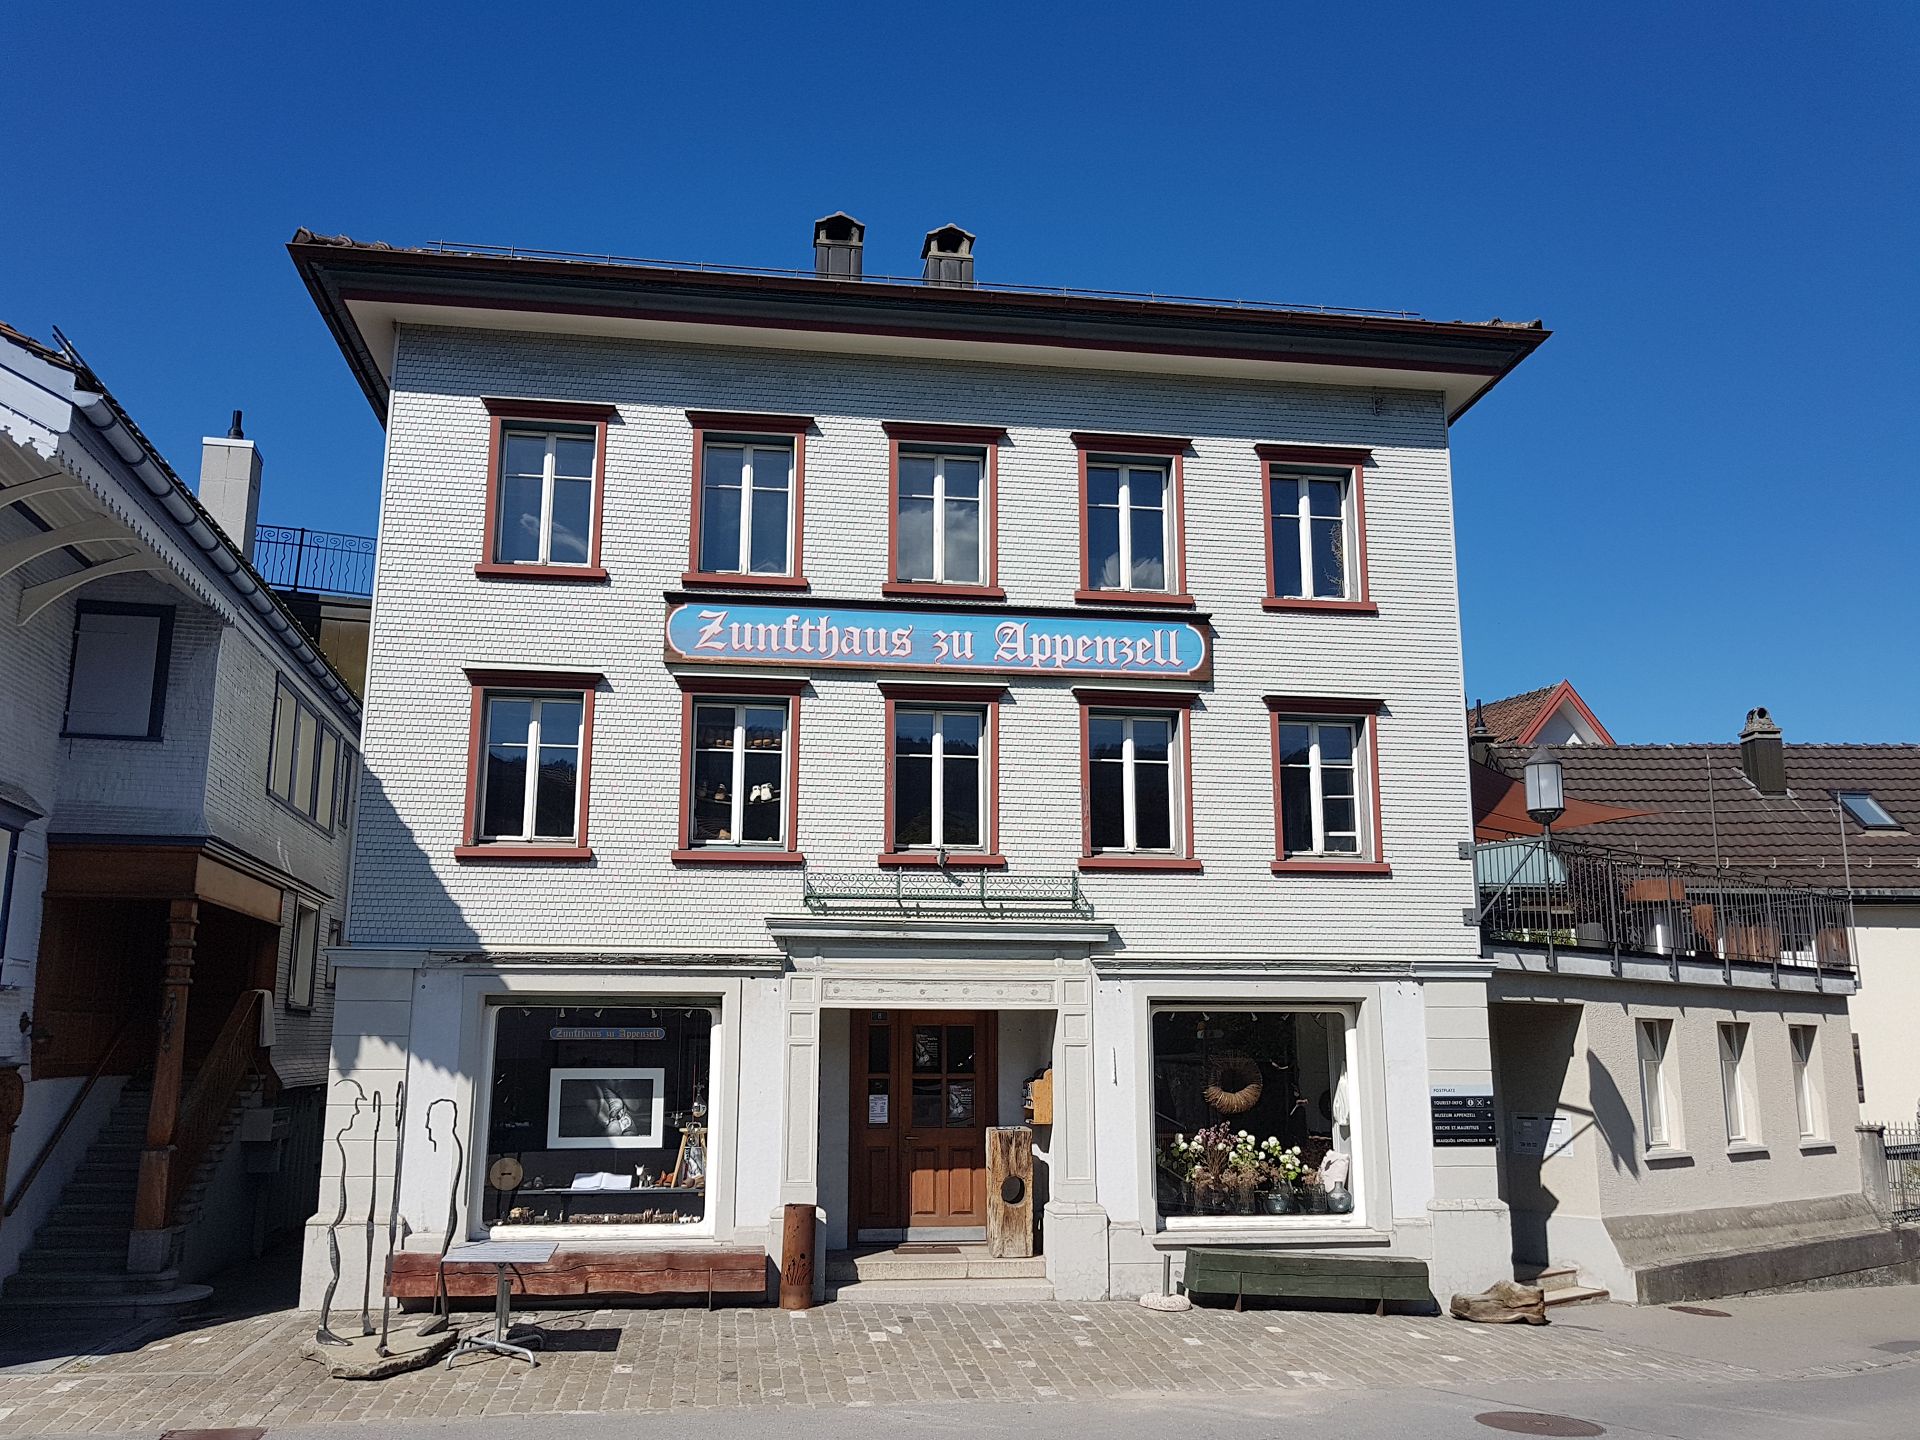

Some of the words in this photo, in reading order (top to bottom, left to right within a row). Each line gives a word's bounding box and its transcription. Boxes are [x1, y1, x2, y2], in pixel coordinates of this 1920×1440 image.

[694, 609, 914, 660] Zunfthaus
[932, 629, 975, 665] zu
[993, 621, 1184, 671] Appenzell
